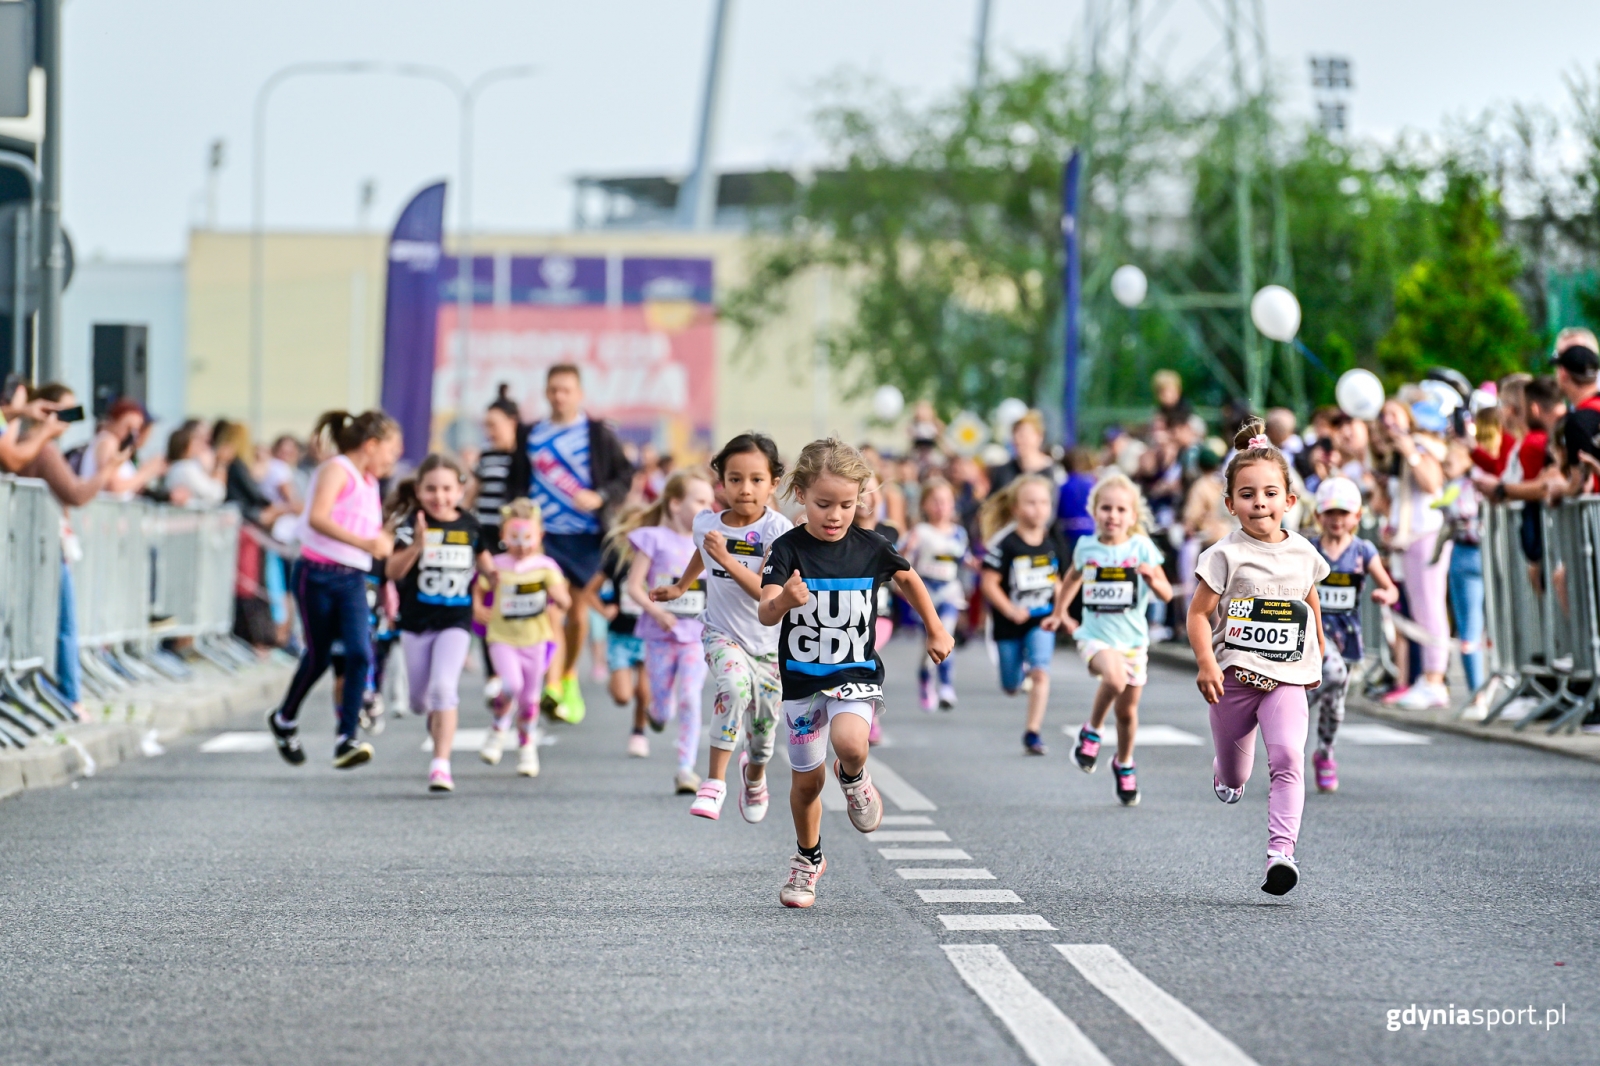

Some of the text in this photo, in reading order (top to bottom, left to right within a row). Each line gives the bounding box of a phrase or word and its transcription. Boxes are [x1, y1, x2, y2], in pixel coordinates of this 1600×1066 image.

[1229, 600, 1254, 610] RUN
[1227, 608, 1252, 618] GDY
[1228, 626, 1289, 645] M5005
[788, 625, 870, 664] GDY
